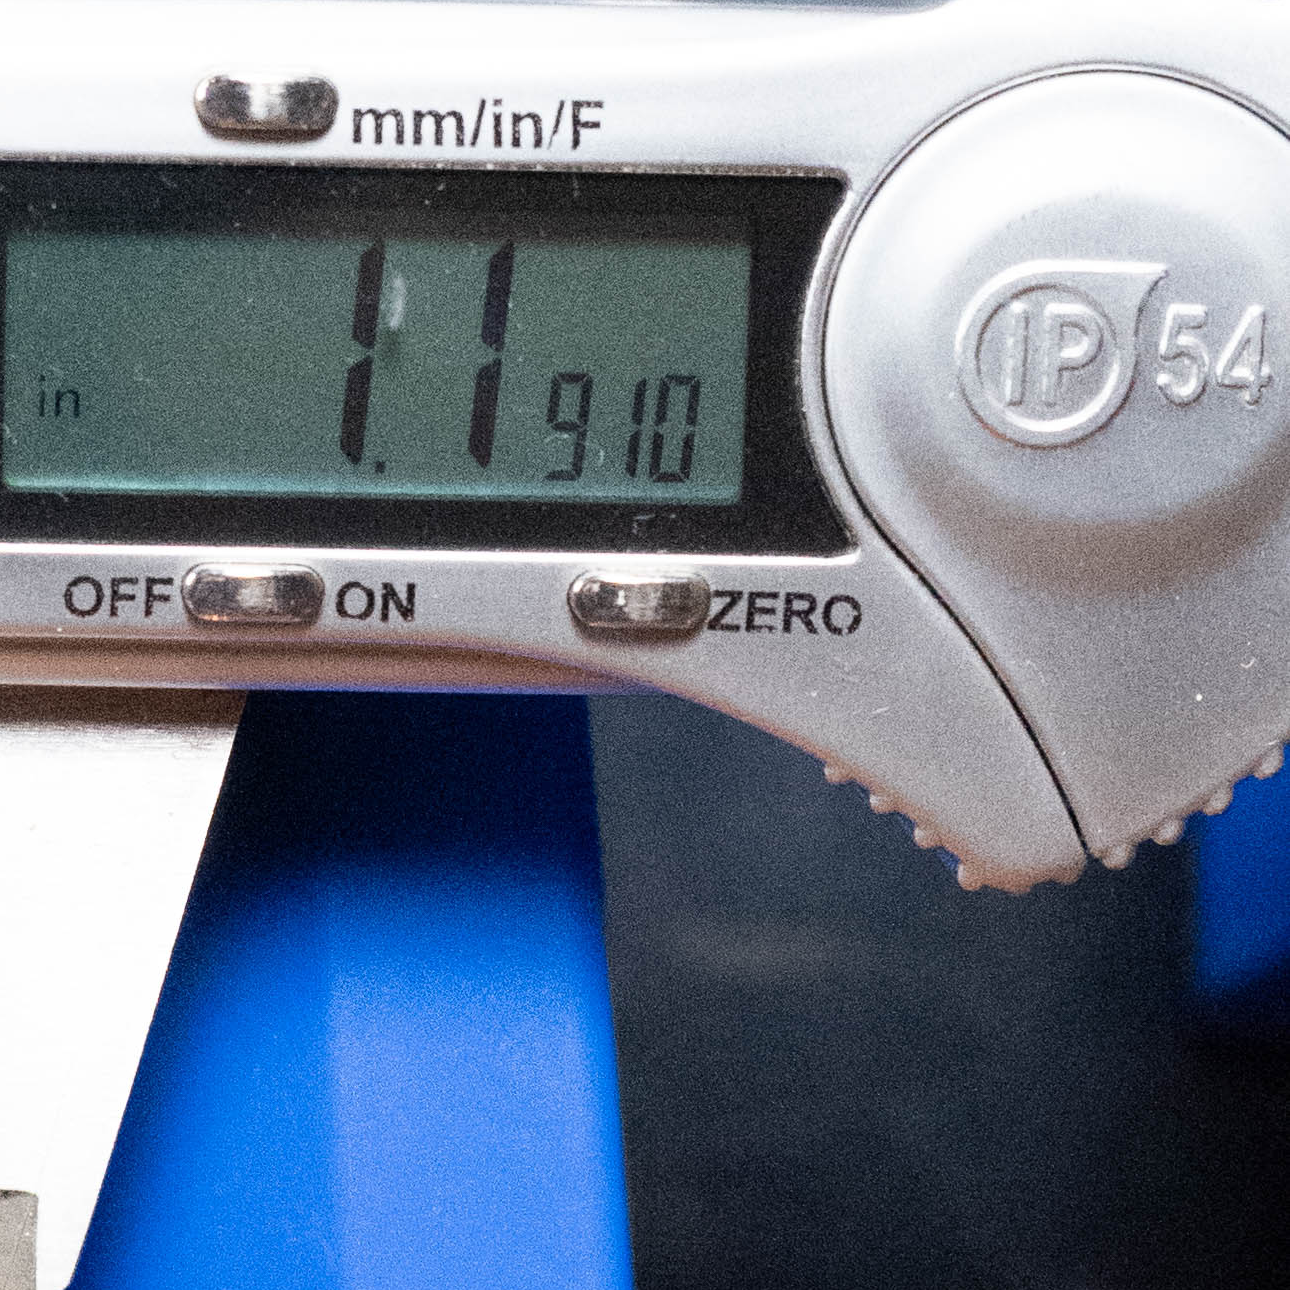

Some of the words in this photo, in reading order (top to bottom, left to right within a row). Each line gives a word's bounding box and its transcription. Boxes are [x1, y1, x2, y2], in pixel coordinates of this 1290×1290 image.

[351, 98, 605, 150] mm/in/F
[1006, 301, 1106, 407] IP
[1157, 302, 1272, 409] 54
[37, 376, 81, 418] in
[64, 576, 172, 619] OFF
[334, 582, 418, 623] ON
[705, 592, 863, 636] ZERO
